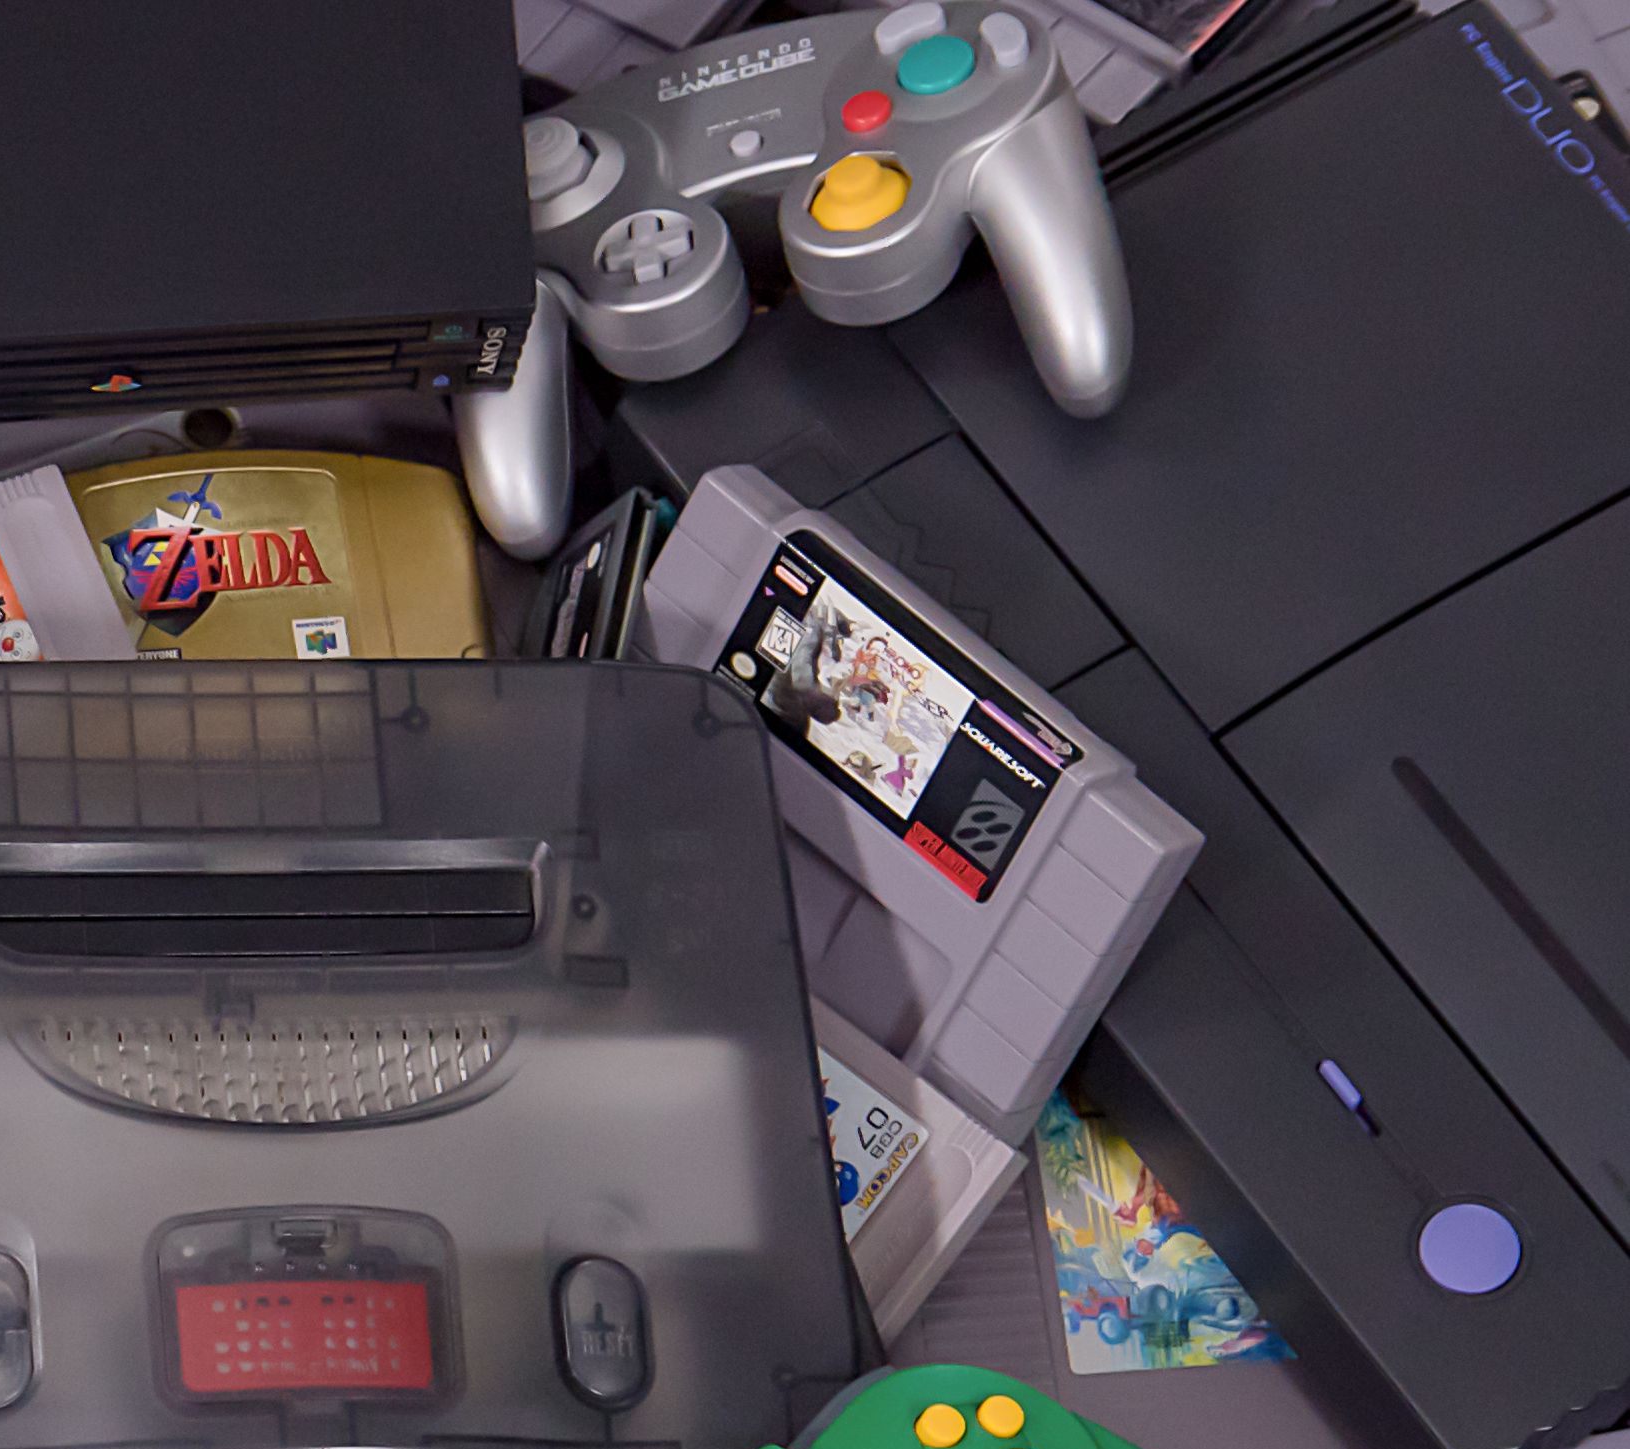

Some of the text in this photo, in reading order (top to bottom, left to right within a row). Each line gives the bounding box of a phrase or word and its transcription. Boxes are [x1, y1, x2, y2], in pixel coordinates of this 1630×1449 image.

[657, 47, 818, 100] GAMECUBE
[659, 36, 816, 93] NINTENDO
[1501, 78, 1593, 175] DUO
[476, 327, 505, 378] SONY
[125, 526, 331, 611] ZELDA
[855, 1133, 919, 1210] CAPCOM
